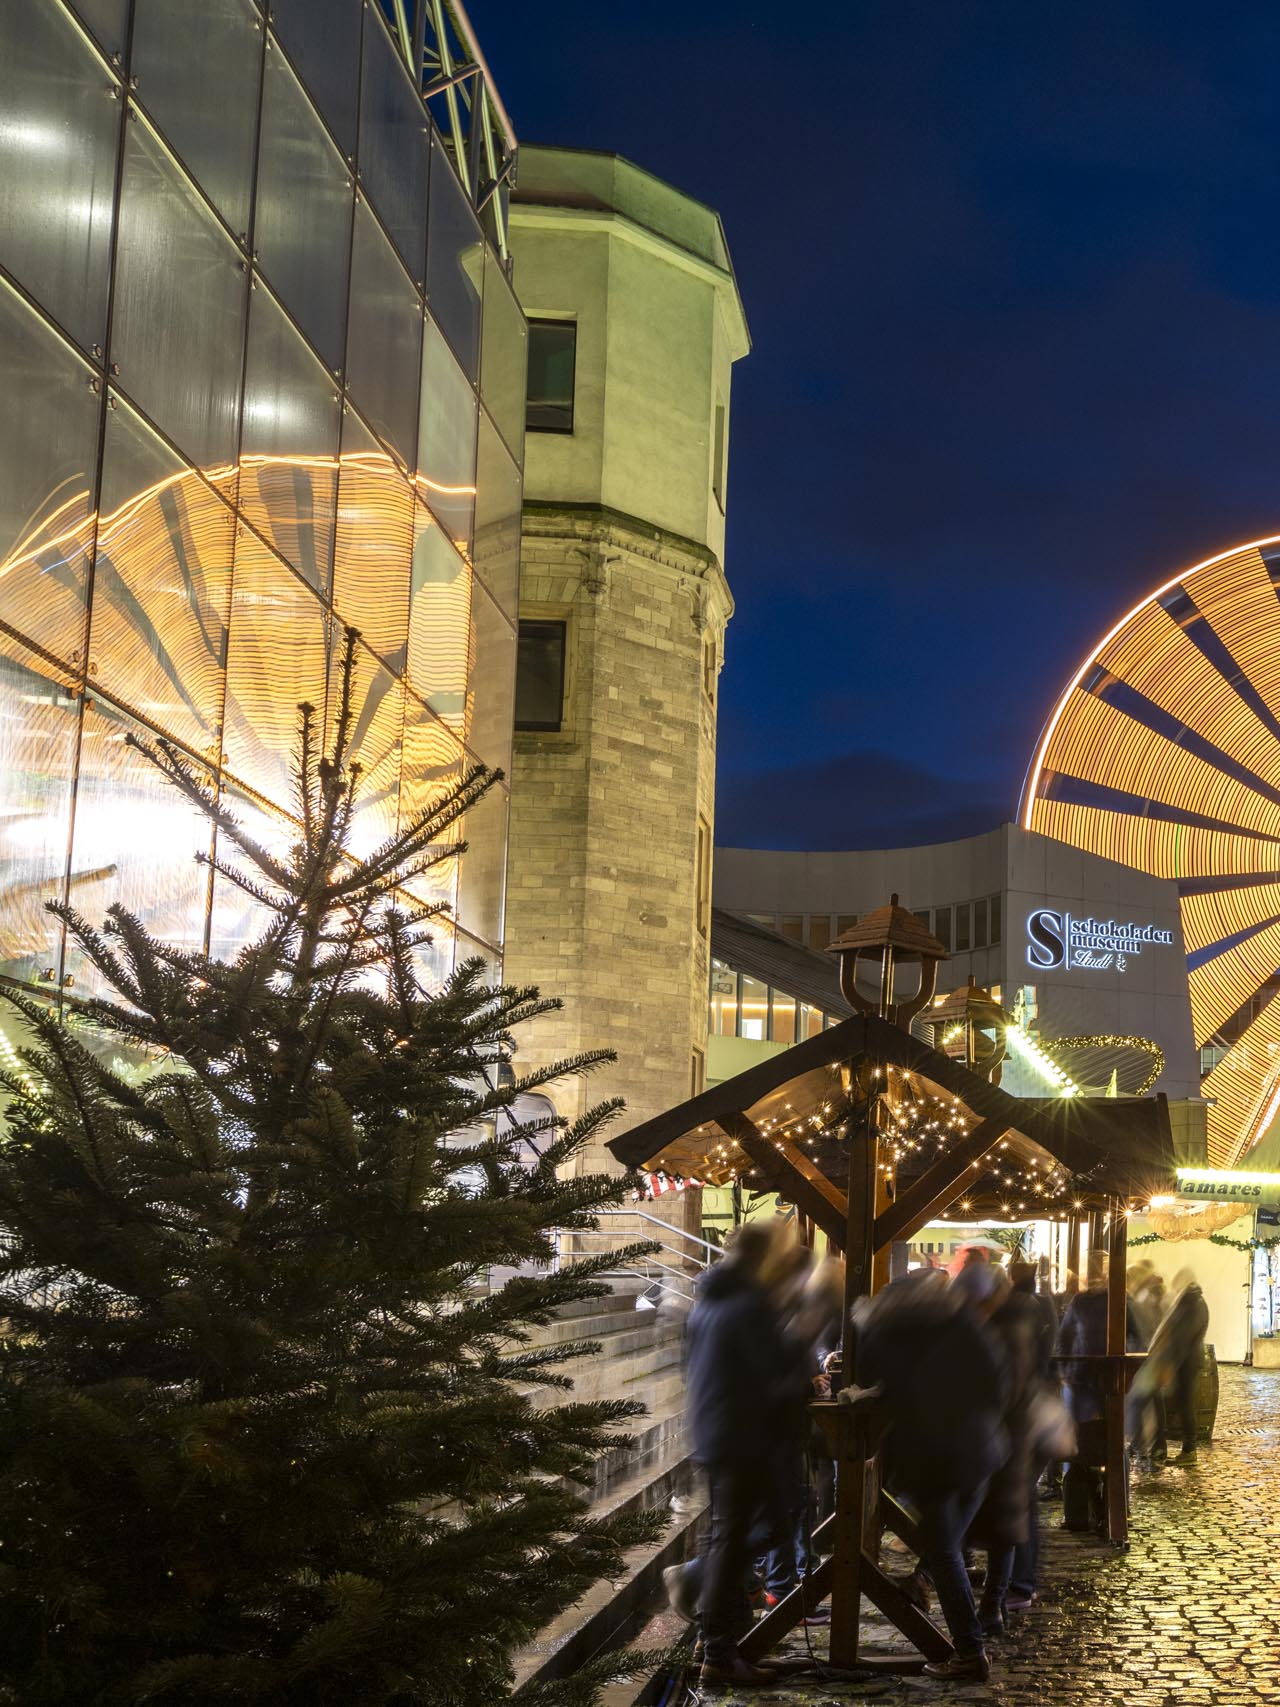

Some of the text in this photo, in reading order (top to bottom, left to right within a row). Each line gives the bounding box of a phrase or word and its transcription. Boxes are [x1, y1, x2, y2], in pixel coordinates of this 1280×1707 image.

[1028, 910, 1064, 968] S
[1071, 918, 1174, 944] schokoladen
[1071, 933, 1141, 954] museum
[1071, 949, 1114, 969] Lindt
